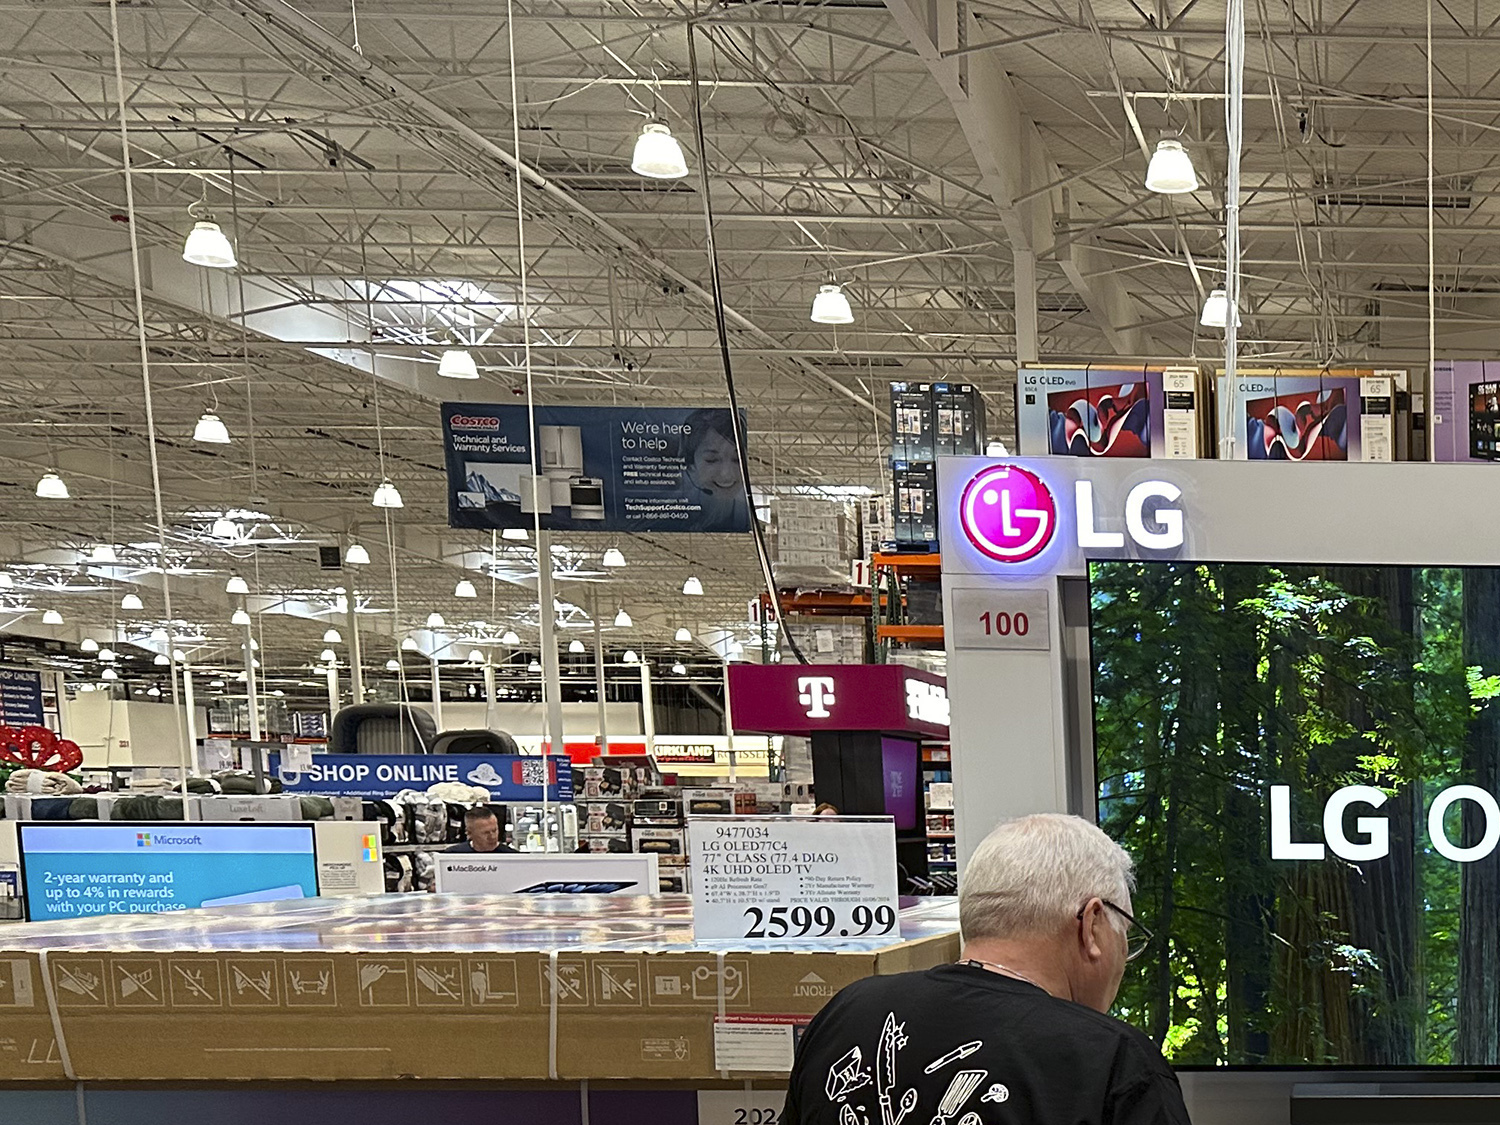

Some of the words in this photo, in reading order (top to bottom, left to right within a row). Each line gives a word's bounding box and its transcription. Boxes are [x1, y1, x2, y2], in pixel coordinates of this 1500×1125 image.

[1024, 376, 1036, 385] LG
[1040, 376, 1064, 385] OLED
[1239, 383, 1263, 392] OLED
[451, 416, 499, 426] COSTCO
[620, 421, 660, 434] We're
[662, 422, 692, 434] here
[452, 434, 490, 444] Technical
[491, 436, 507, 444] and
[622, 437, 636, 448] to
[639, 437, 668, 450] help
[452, 443, 490, 453] Warranty
[492, 444, 526, 452] Services
[625, 504, 701, 512] TechSupport.Costco.com
[1074, 480, 1184, 550] LG
[979, 611, 1030, 636] 100
[654, 745, 713, 756] KIRKLAND
[308, 764, 367, 782] SHOP
[385, 764, 459, 782] ONLINE
[1270, 785, 1390, 863] LG
[716, 826, 770, 838] 9477034
[153, 834, 202, 846] Microsoft
[702, 841, 720, 852] LG
[724, 841, 788, 852] OLED77C4
[702, 853, 722, 864] 77"
[726, 853, 767, 864] CLASS
[770, 852, 798, 864] (77.4
[802, 852, 839, 864] DIAG)
[702, 864, 720, 875] 4K
[724, 864, 752, 875] UHD
[756, 864, 792, 874] OLED
[794, 864, 813, 874] TV
[44, 872, 85, 886] 2-year
[88, 873, 146, 886] warranty
[148, 872, 174, 884] and
[46, 889, 64, 899] up
[66, 888, 80, 898] to
[83, 886, 104, 898] 4%
[107, 886, 120, 898] in
[122, 886, 174, 898] rewards
[46, 901, 74, 913] with
[76, 904, 106, 914] your
[109, 902, 128, 913] PC
[130, 902, 187, 914] purchase
[743, 904, 896, 938] 2599.99
[794, 983, 834, 998] FRONT
[734, 1108, 780, 1125] 202
